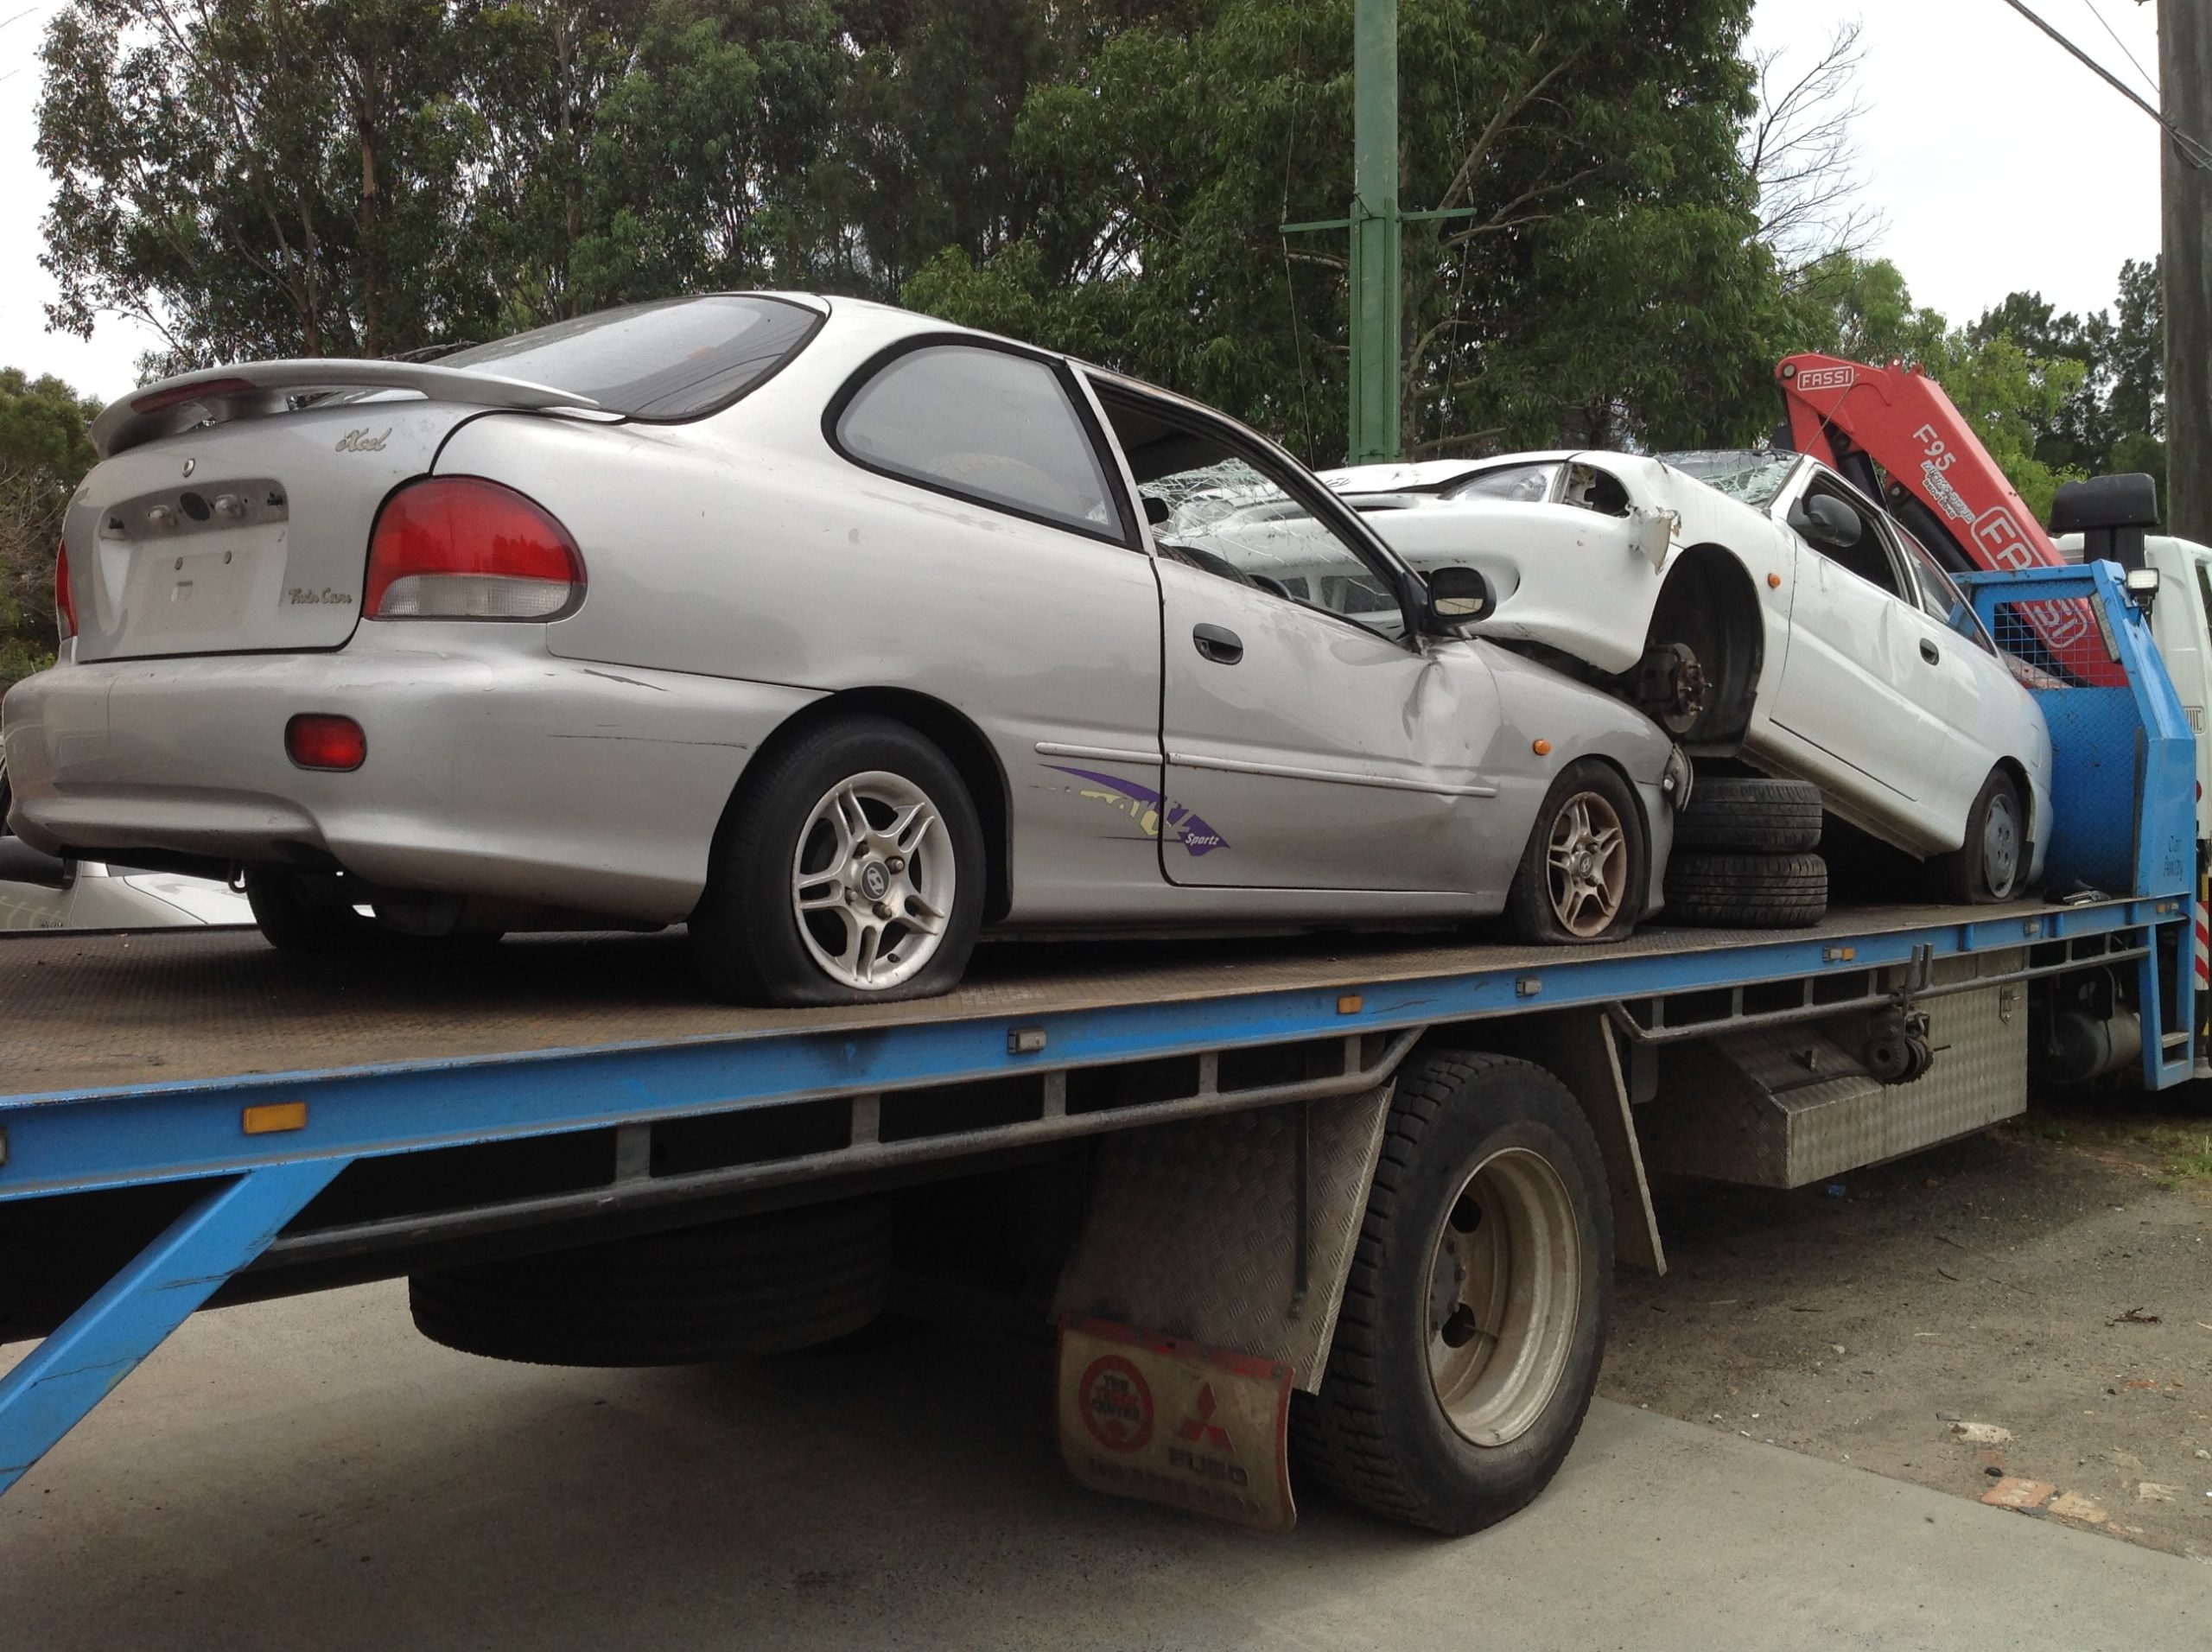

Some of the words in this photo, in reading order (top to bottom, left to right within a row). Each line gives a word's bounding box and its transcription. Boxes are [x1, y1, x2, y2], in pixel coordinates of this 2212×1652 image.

[1802, 370, 1849, 387] FASSI
[1912, 423, 1956, 471] F95
[1980, 517, 2078, 638] FASI
[1185, 833, 1219, 846] Sportz
